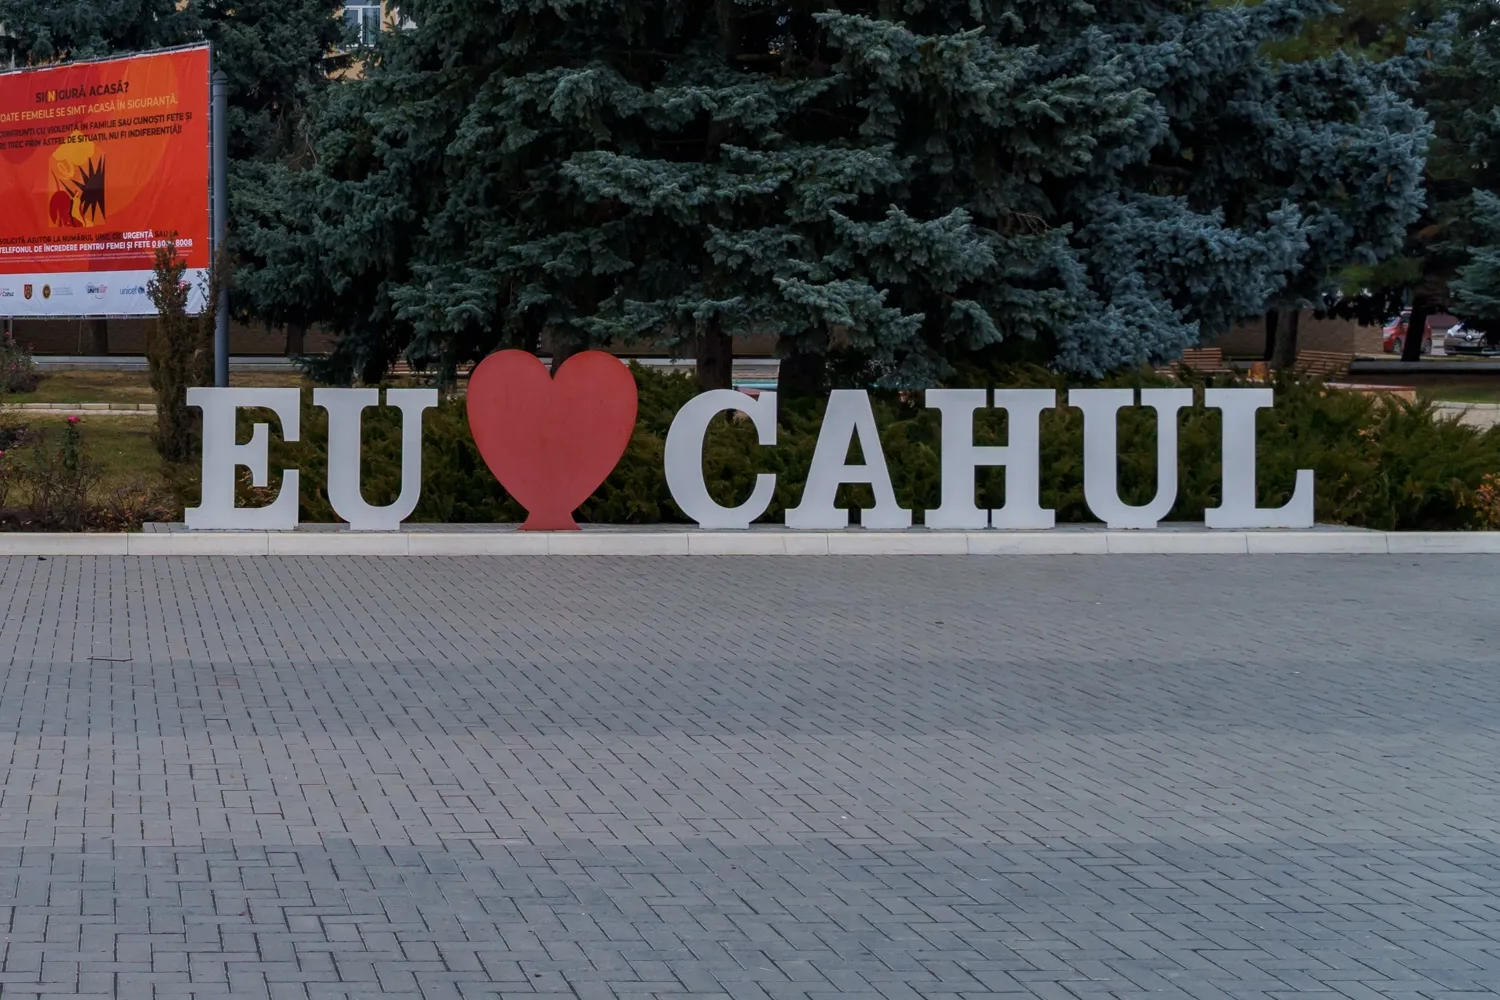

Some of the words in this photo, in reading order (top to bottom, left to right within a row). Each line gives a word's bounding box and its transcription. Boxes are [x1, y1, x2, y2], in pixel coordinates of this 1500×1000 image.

[89, 79, 129, 96] ACASĂ?
[21, 109, 54, 120] FEMEILE
[56, 108, 66, 118] SE
[67, 105, 87, 116] SIMT
[88, 101, 116, 114] ACASĂ
[36, 127, 46, 136] CU
[90, 118, 117, 130] FAMILIE
[118, 117, 132, 127] SAU
[166, 112, 184, 122] FETE
[8, 140, 24, 149] TREC
[25, 138, 42, 148] PRIN
[43, 136, 66, 147] ASTFEL
[67, 135, 76, 144] DE
[108, 131, 120, 140] NU
[120, 130, 127, 139] FI
[53, 234, 61, 243] LA
[154, 230, 168, 238] SAU
[34, 245, 42, 253] DE
[43, 242, 78, 253] ÎNCREDERE
[80, 242, 104, 251] PENTRU
[106, 241, 126, 250] FEMEI
[134, 239, 151, 248] FETE
[120, 285, 137, 295] unicef
[185, 387, 438, 530] EU
[663, 388, 1314, 530] CAHUL
